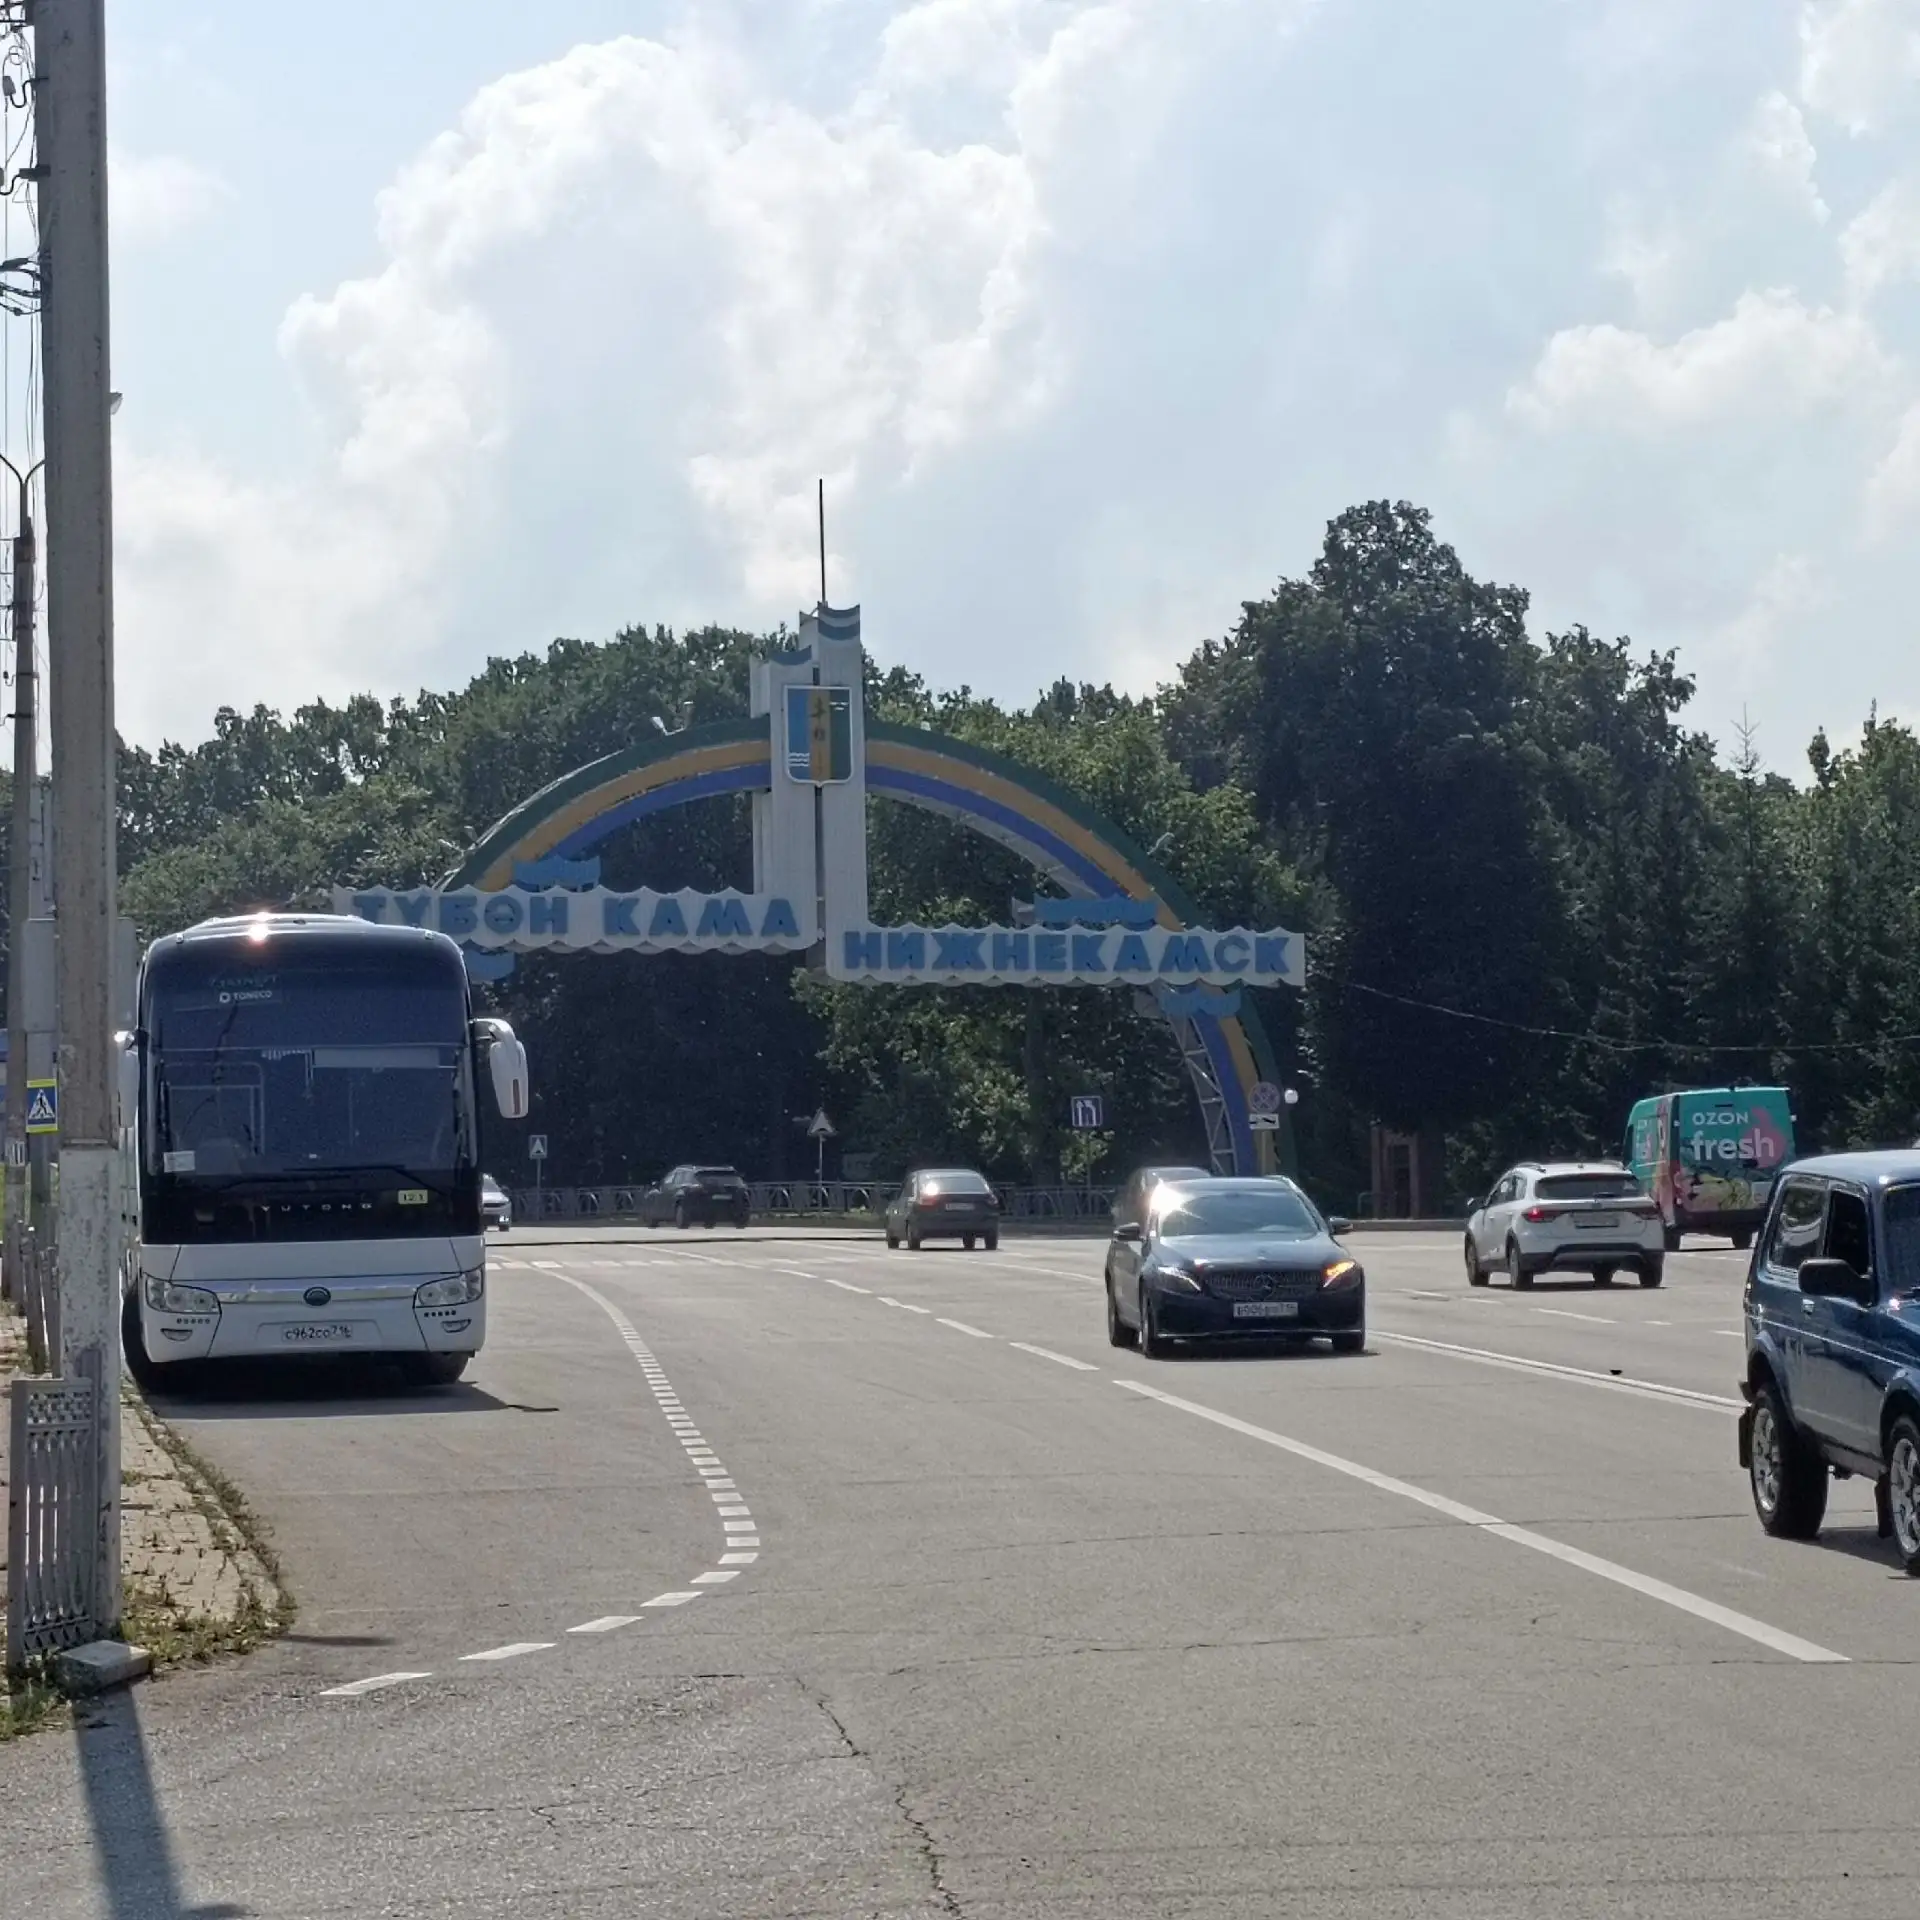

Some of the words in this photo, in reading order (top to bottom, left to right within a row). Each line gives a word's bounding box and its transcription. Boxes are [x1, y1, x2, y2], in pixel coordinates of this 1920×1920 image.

[604, 896, 800, 938] КАМА
[844, 930, 1291, 975] НИЖНЕКАМСК
[1691, 1111, 1749, 1126] OZON
[1691, 1128, 1774, 1161] fresh
